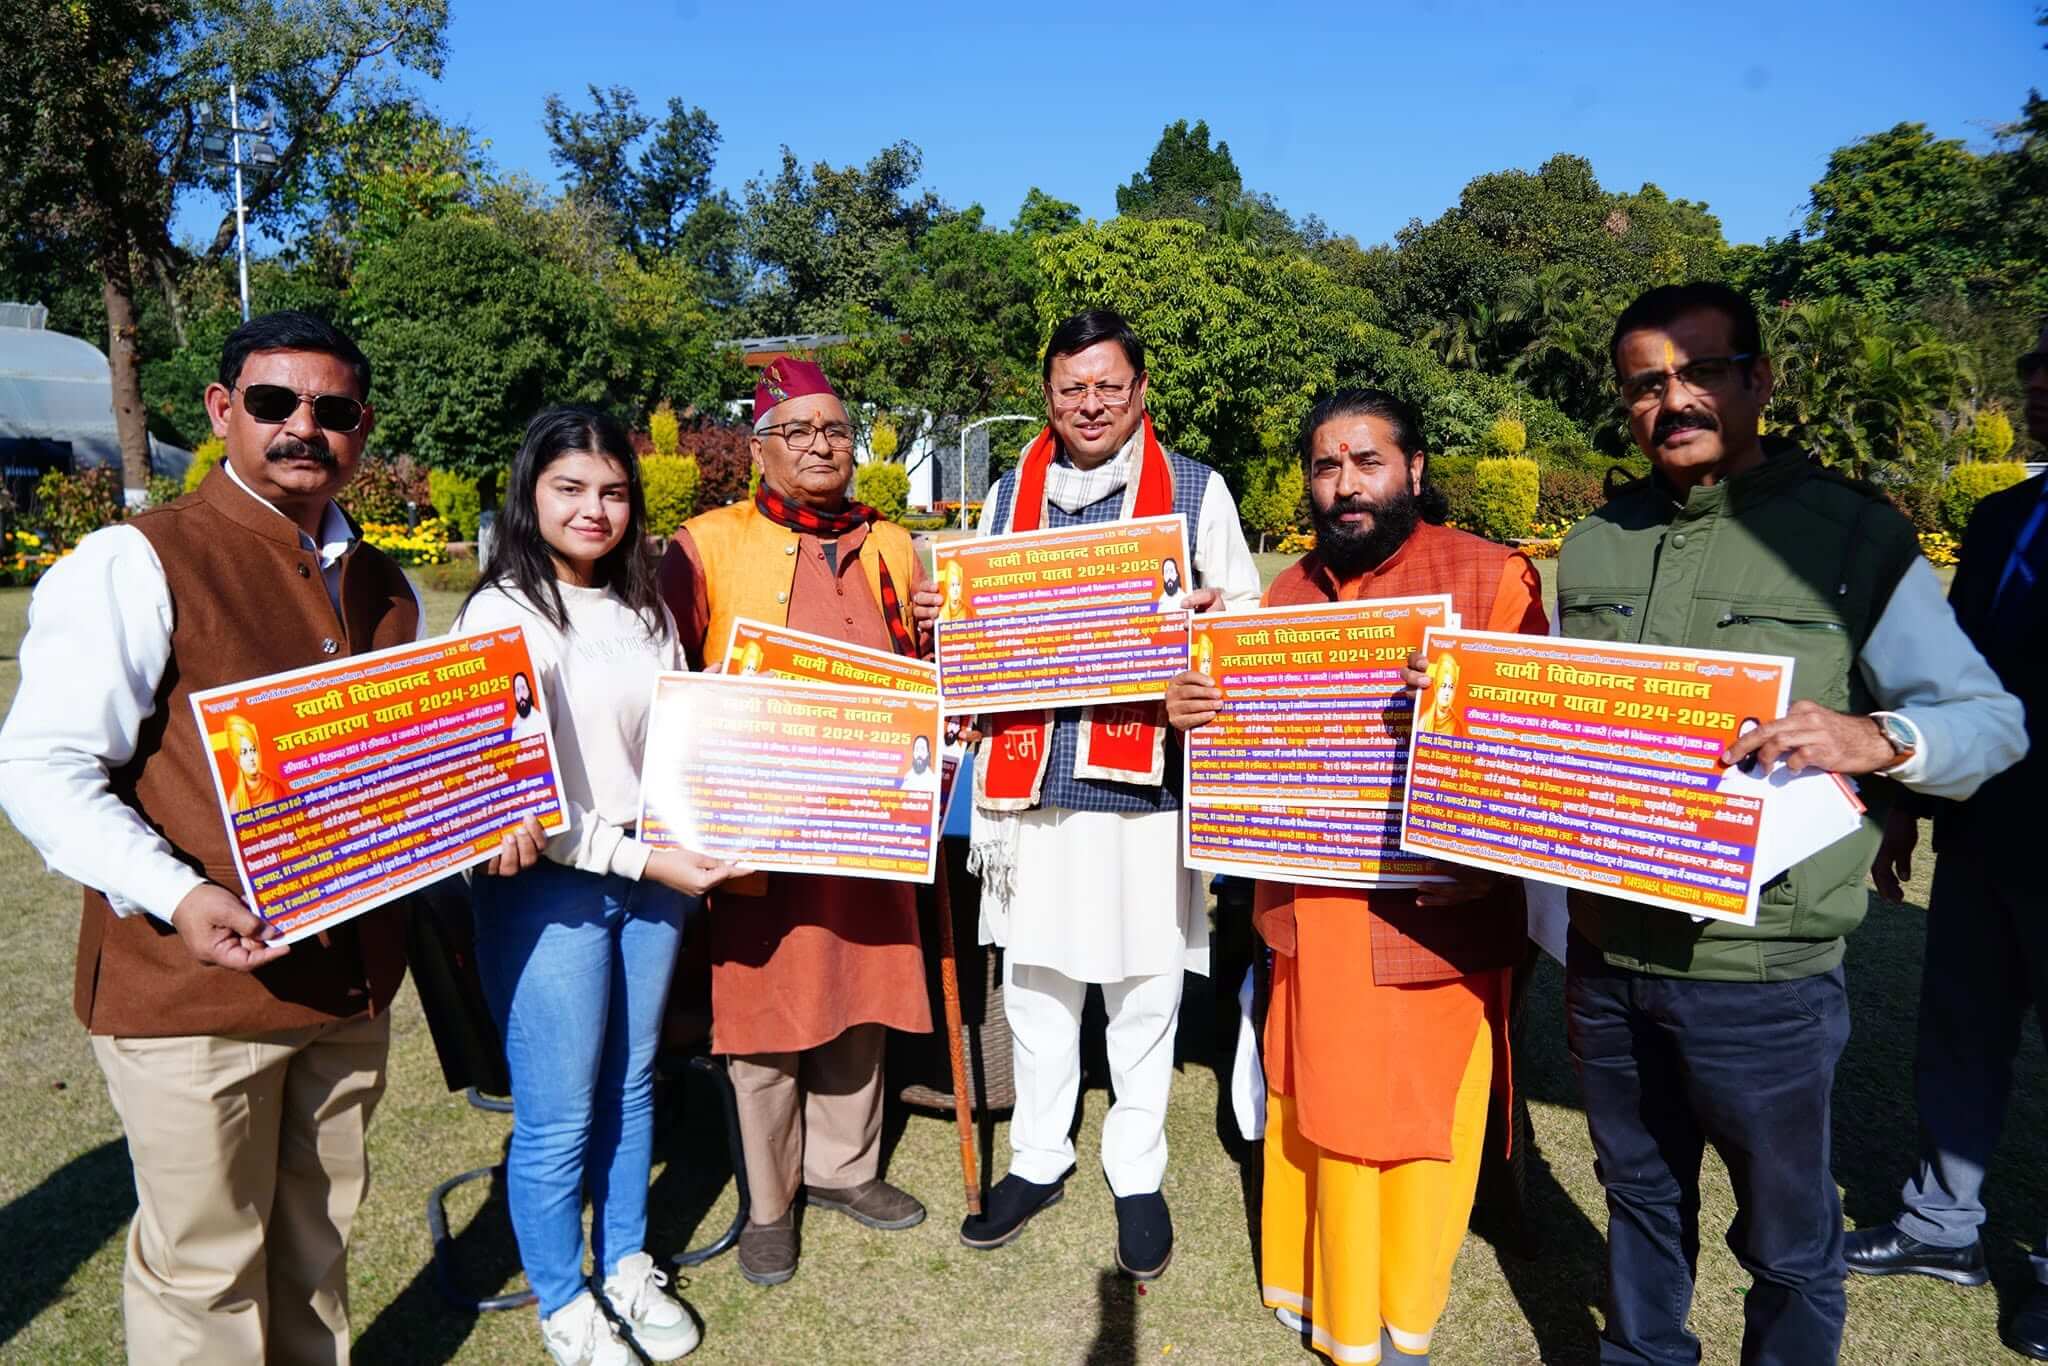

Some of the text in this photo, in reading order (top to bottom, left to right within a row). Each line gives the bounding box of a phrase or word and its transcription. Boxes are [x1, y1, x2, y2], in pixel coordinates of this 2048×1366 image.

[987, 550, 1021, 568] स्वामी
[1024, 546, 1089, 564] विवेकानन्द
[1094, 540, 1139, 557] सनातन
[971, 558, 1159, 588] जनजागरण यात्रा 2024-2025
[1236, 624, 1395, 646] स्वामी विवेकानन्द सनातन
[792, 652, 829, 672] स्वामी
[831, 661, 892, 688] विवेकानन्द
[1220, 651, 1286, 667] जनजागरण
[1290, 649, 1322, 664] यात्रा
[292, 689, 343, 718] स्वामी
[347, 670, 430, 705] विवेकानन्द
[434, 655, 485, 681] सनातन
[1494, 660, 1712, 699] स्वामी विवेकानन्द सनातन
[273, 713, 368, 751] जनजागरण
[374, 701, 413, 723] यात्रा
[419, 674, 510, 711] 2024-2025
[767, 699, 838, 719] विवेकानन्द
[843, 707, 892, 724] सनातन
[1468, 683, 1736, 730] जनजागरण यात्रा 2024-2025
[822, 726, 911, 746] 2024-2025
[1004, 728, 1038, 761] राम
